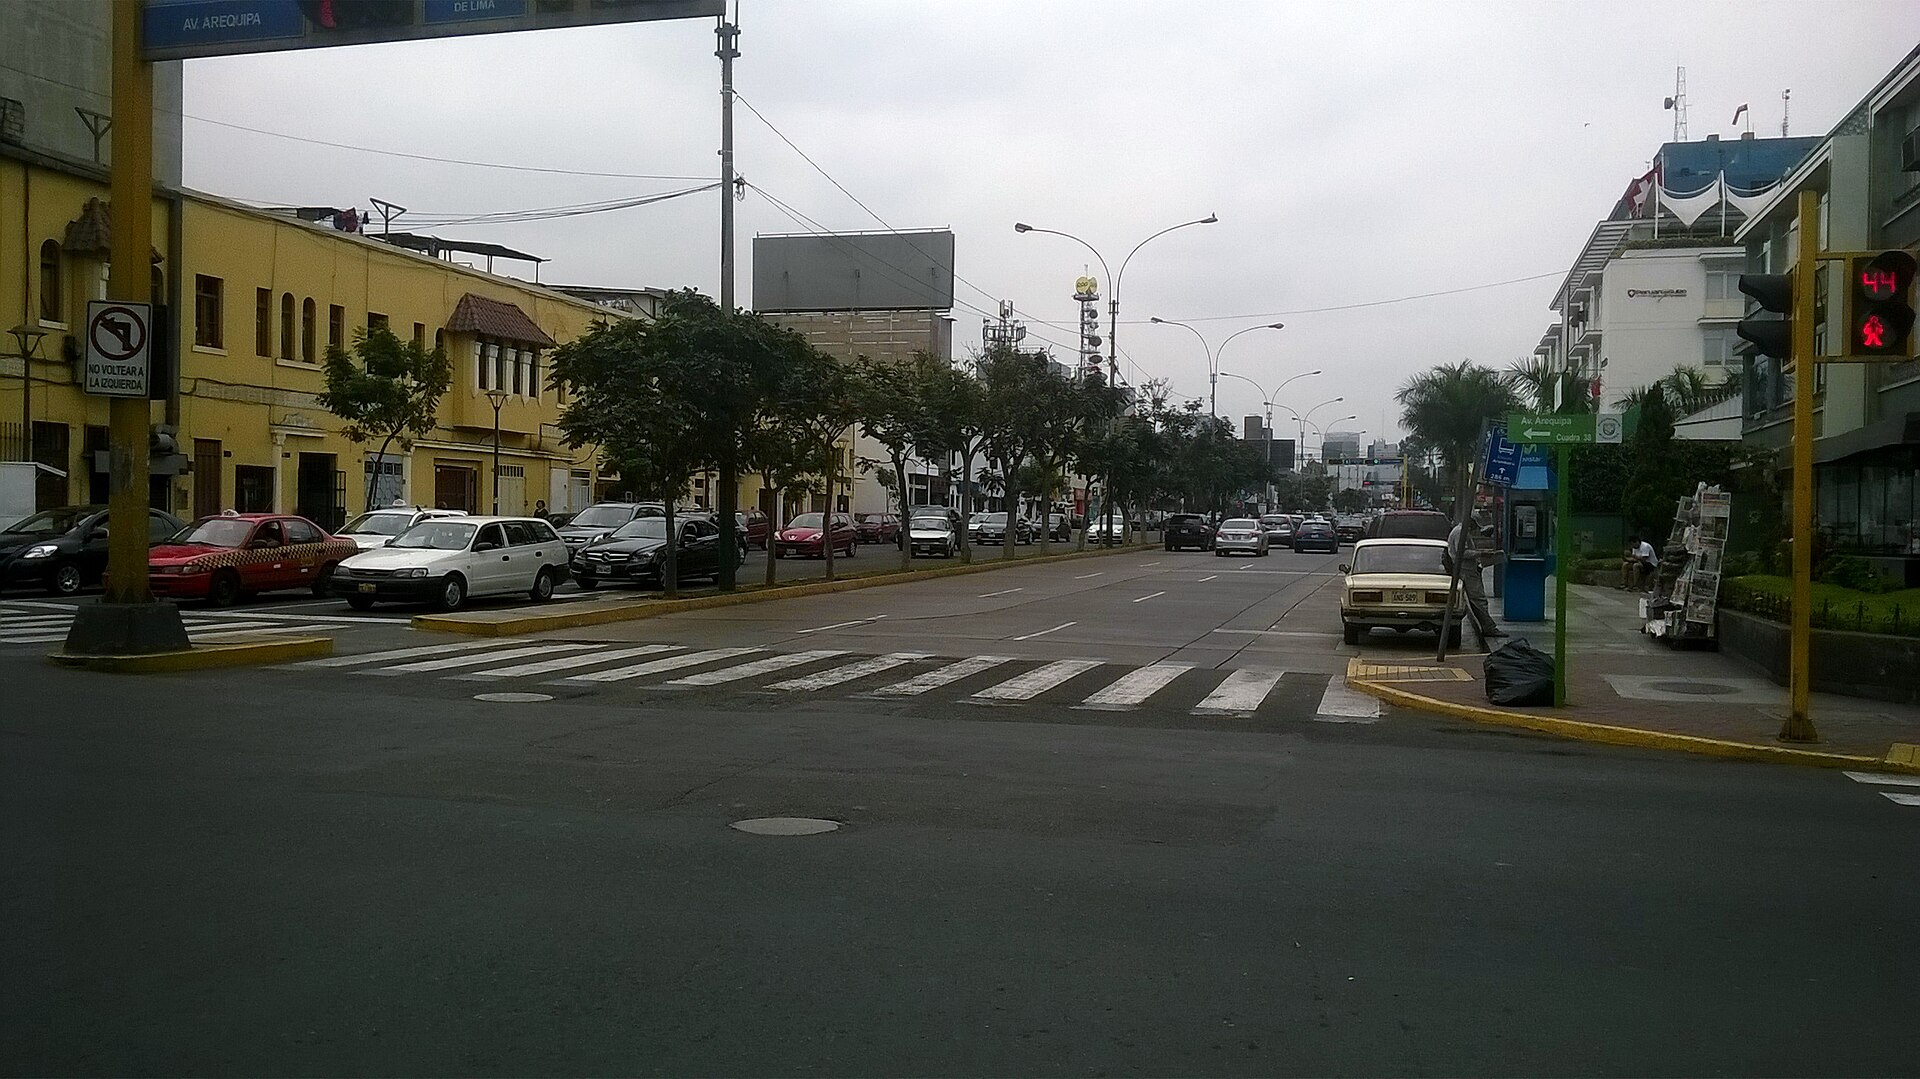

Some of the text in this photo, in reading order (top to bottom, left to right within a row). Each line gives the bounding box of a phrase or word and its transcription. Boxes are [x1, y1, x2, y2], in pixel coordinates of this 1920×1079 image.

[454, 0, 495, 12] DE LIMA
[202, 12, 262, 29] AREQUIPA
[1862, 271, 1897, 294] 44
[88, 364, 144, 376] NO VOLTEAR A
[89, 377, 143, 390] LA IZQUIERDA
[1520, 416, 1572, 427] Av. Arequipa
[1556, 433, 1581, 442] Cuadra
